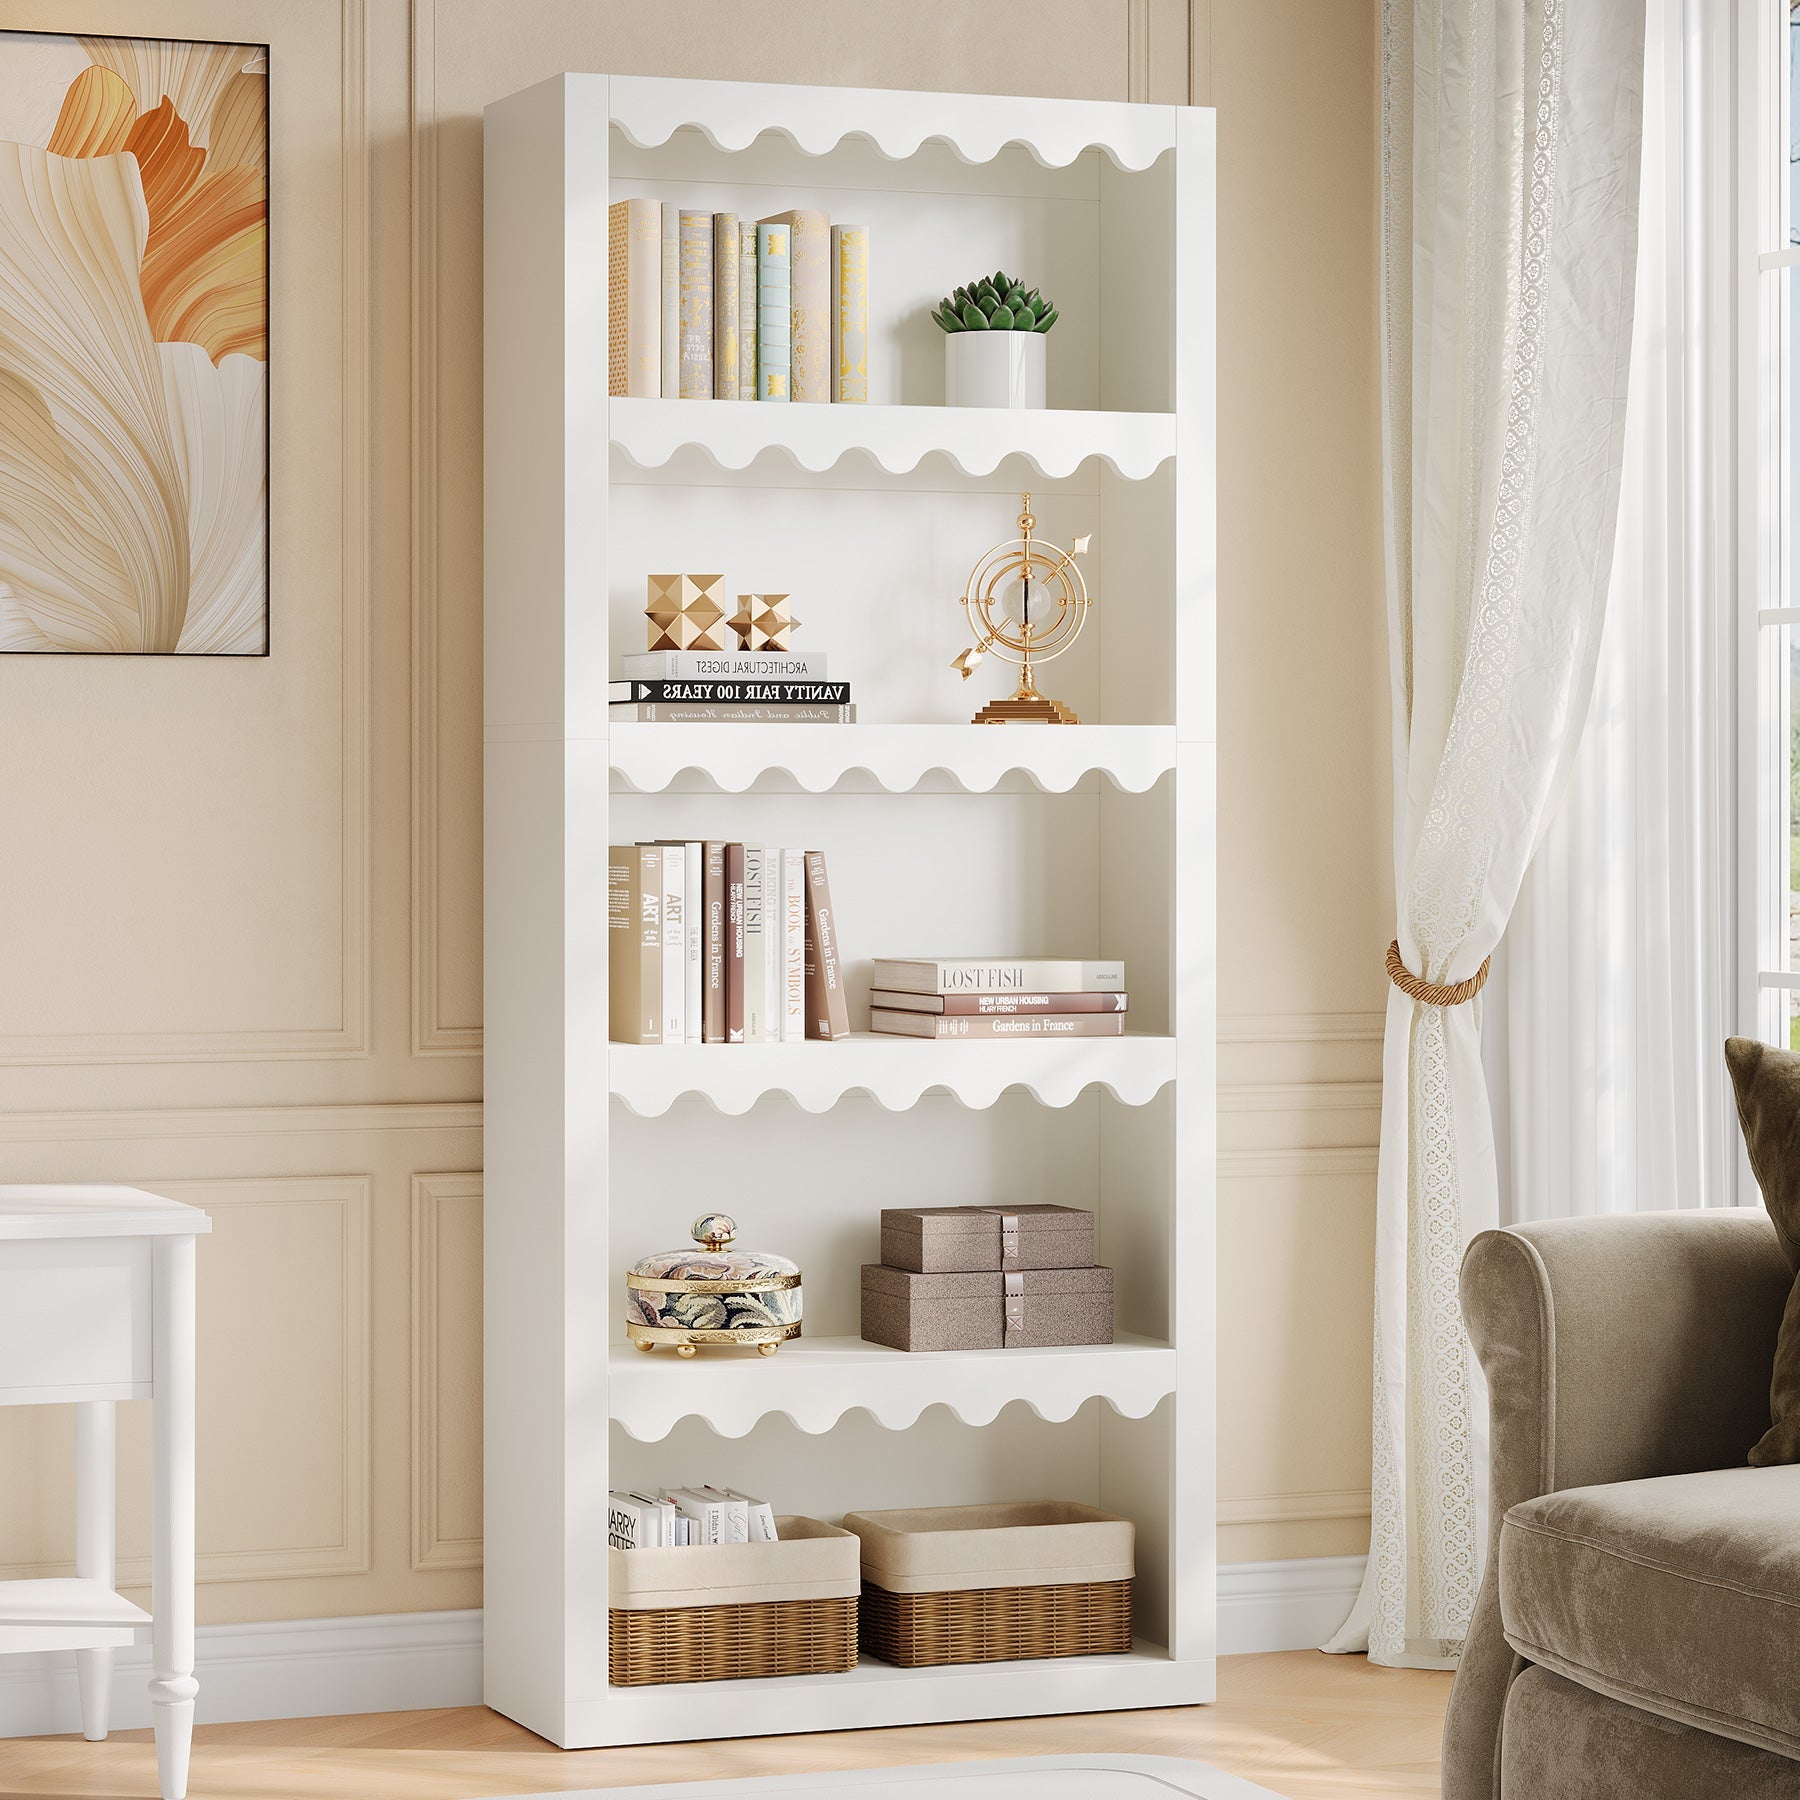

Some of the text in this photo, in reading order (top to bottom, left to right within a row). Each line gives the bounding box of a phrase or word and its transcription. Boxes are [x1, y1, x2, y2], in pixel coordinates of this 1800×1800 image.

[687, 334, 701, 344] PR
[746, 849, 761, 934] LOST FISH
[767, 858, 777, 906] MAKING
[642, 893, 659, 925] ART
[666, 893, 682, 925] ART
[735, 883, 743, 958] NEW URBAN HOUSING
[767, 908, 777, 921] IT
[788, 895, 801, 933] BOOK
[712, 901, 722, 989] Gardens in France
[818, 908, 837, 990] Gardens in France
[788, 947, 801, 1016] SYMBOLS
[943, 968, 1023, 988] LOST FISH
[979, 995, 1049, 1006] NEW URBAN HOUSING
[979, 1005, 997, 1013] HILARY
[992, 1018, 1074, 1033] Gardens in France
